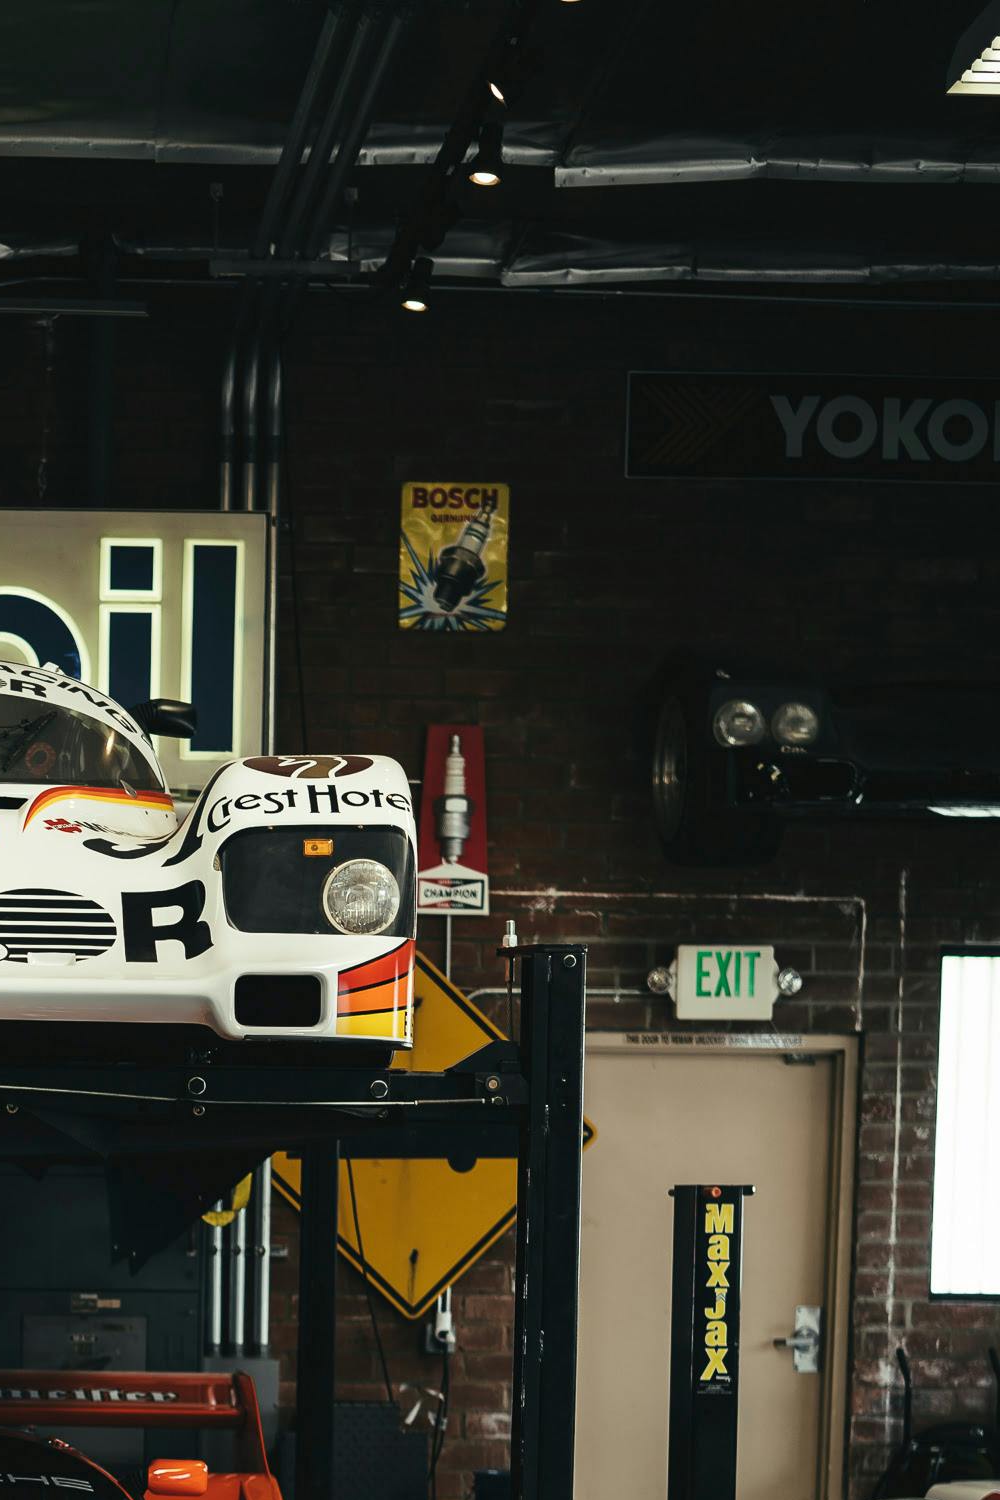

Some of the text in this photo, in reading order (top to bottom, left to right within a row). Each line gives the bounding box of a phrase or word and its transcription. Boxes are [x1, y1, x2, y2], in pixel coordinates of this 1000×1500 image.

[769, 395, 1000, 462] YOKO
[411, 487, 498, 510] BOSCH
[206, 784, 411, 834] Crest Hote
[423, 888, 477, 898] CHAMPION
[695, 950, 762, 998] EXIT
